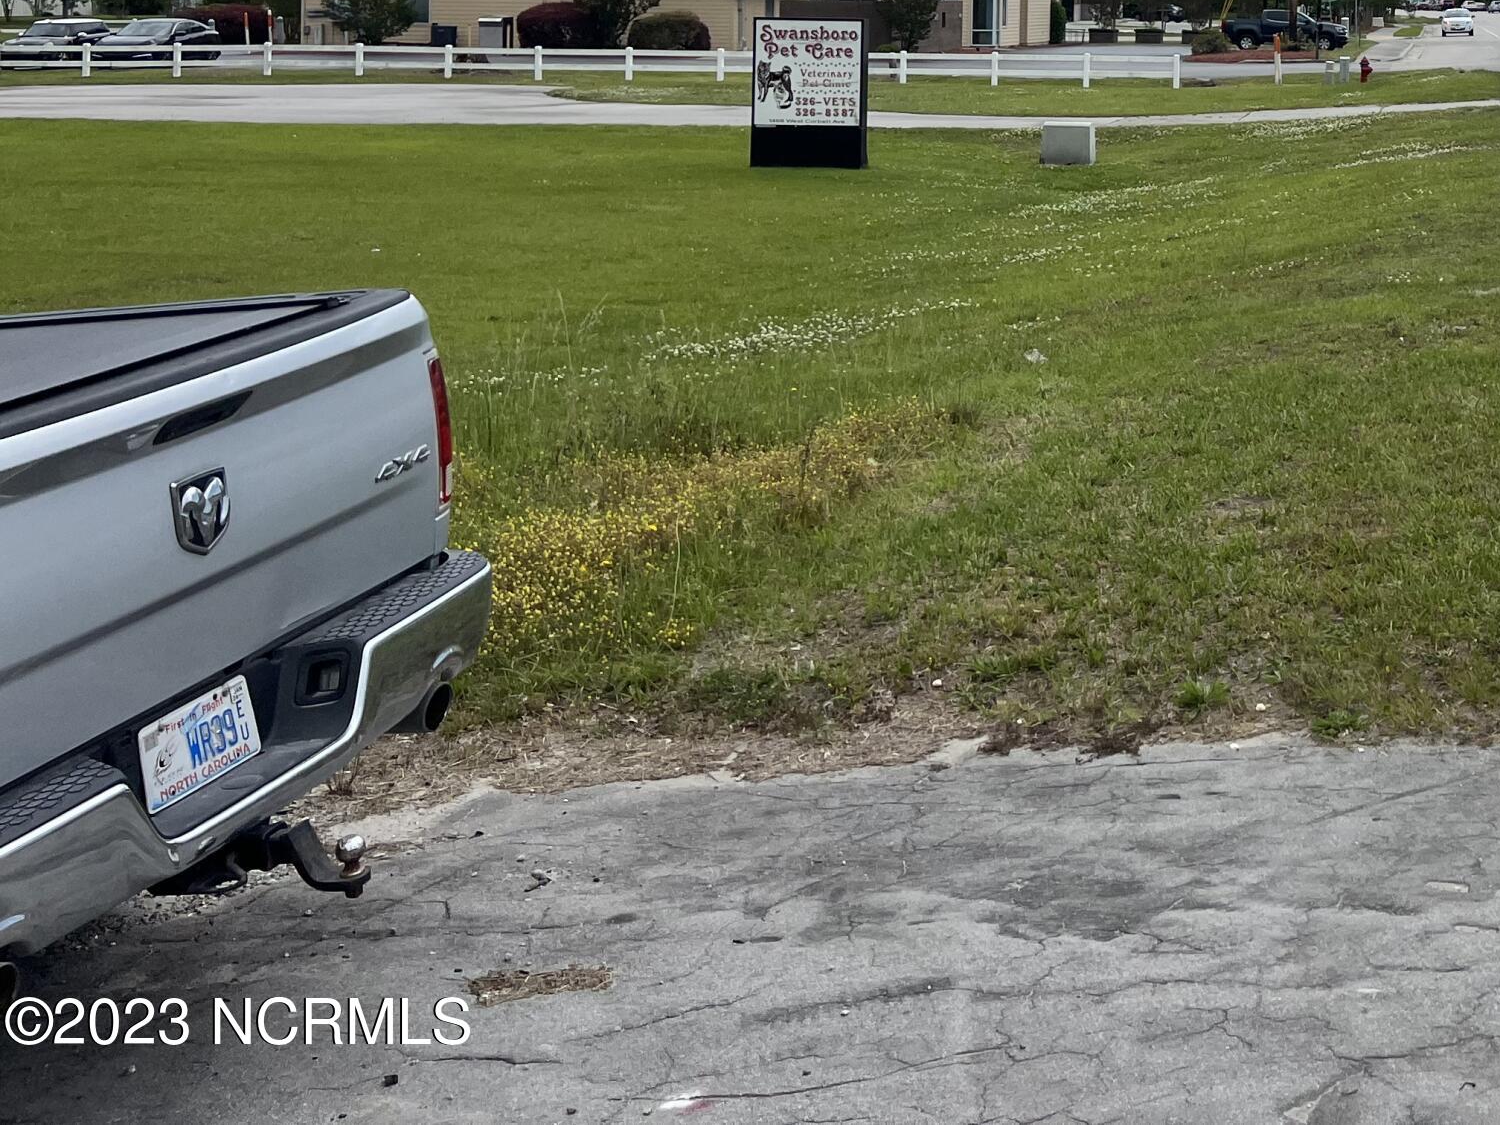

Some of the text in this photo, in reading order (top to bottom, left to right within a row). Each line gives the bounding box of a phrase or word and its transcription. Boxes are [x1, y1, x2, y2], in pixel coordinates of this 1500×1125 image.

[760, 24, 859, 42] Swansboro
[764, 42, 854, 60] Pet Care
[800, 68, 853, 79] Veterinary
[802, 79, 850, 88] Pet Clinic
[795, 97, 857, 107] 326-VETS
[795, 108, 855, 117] 326-8387
[164, 718, 185, 734] First
[202, 696, 224, 716] Flight
[160, 743, 251, 802] NORTH CAROLINA
